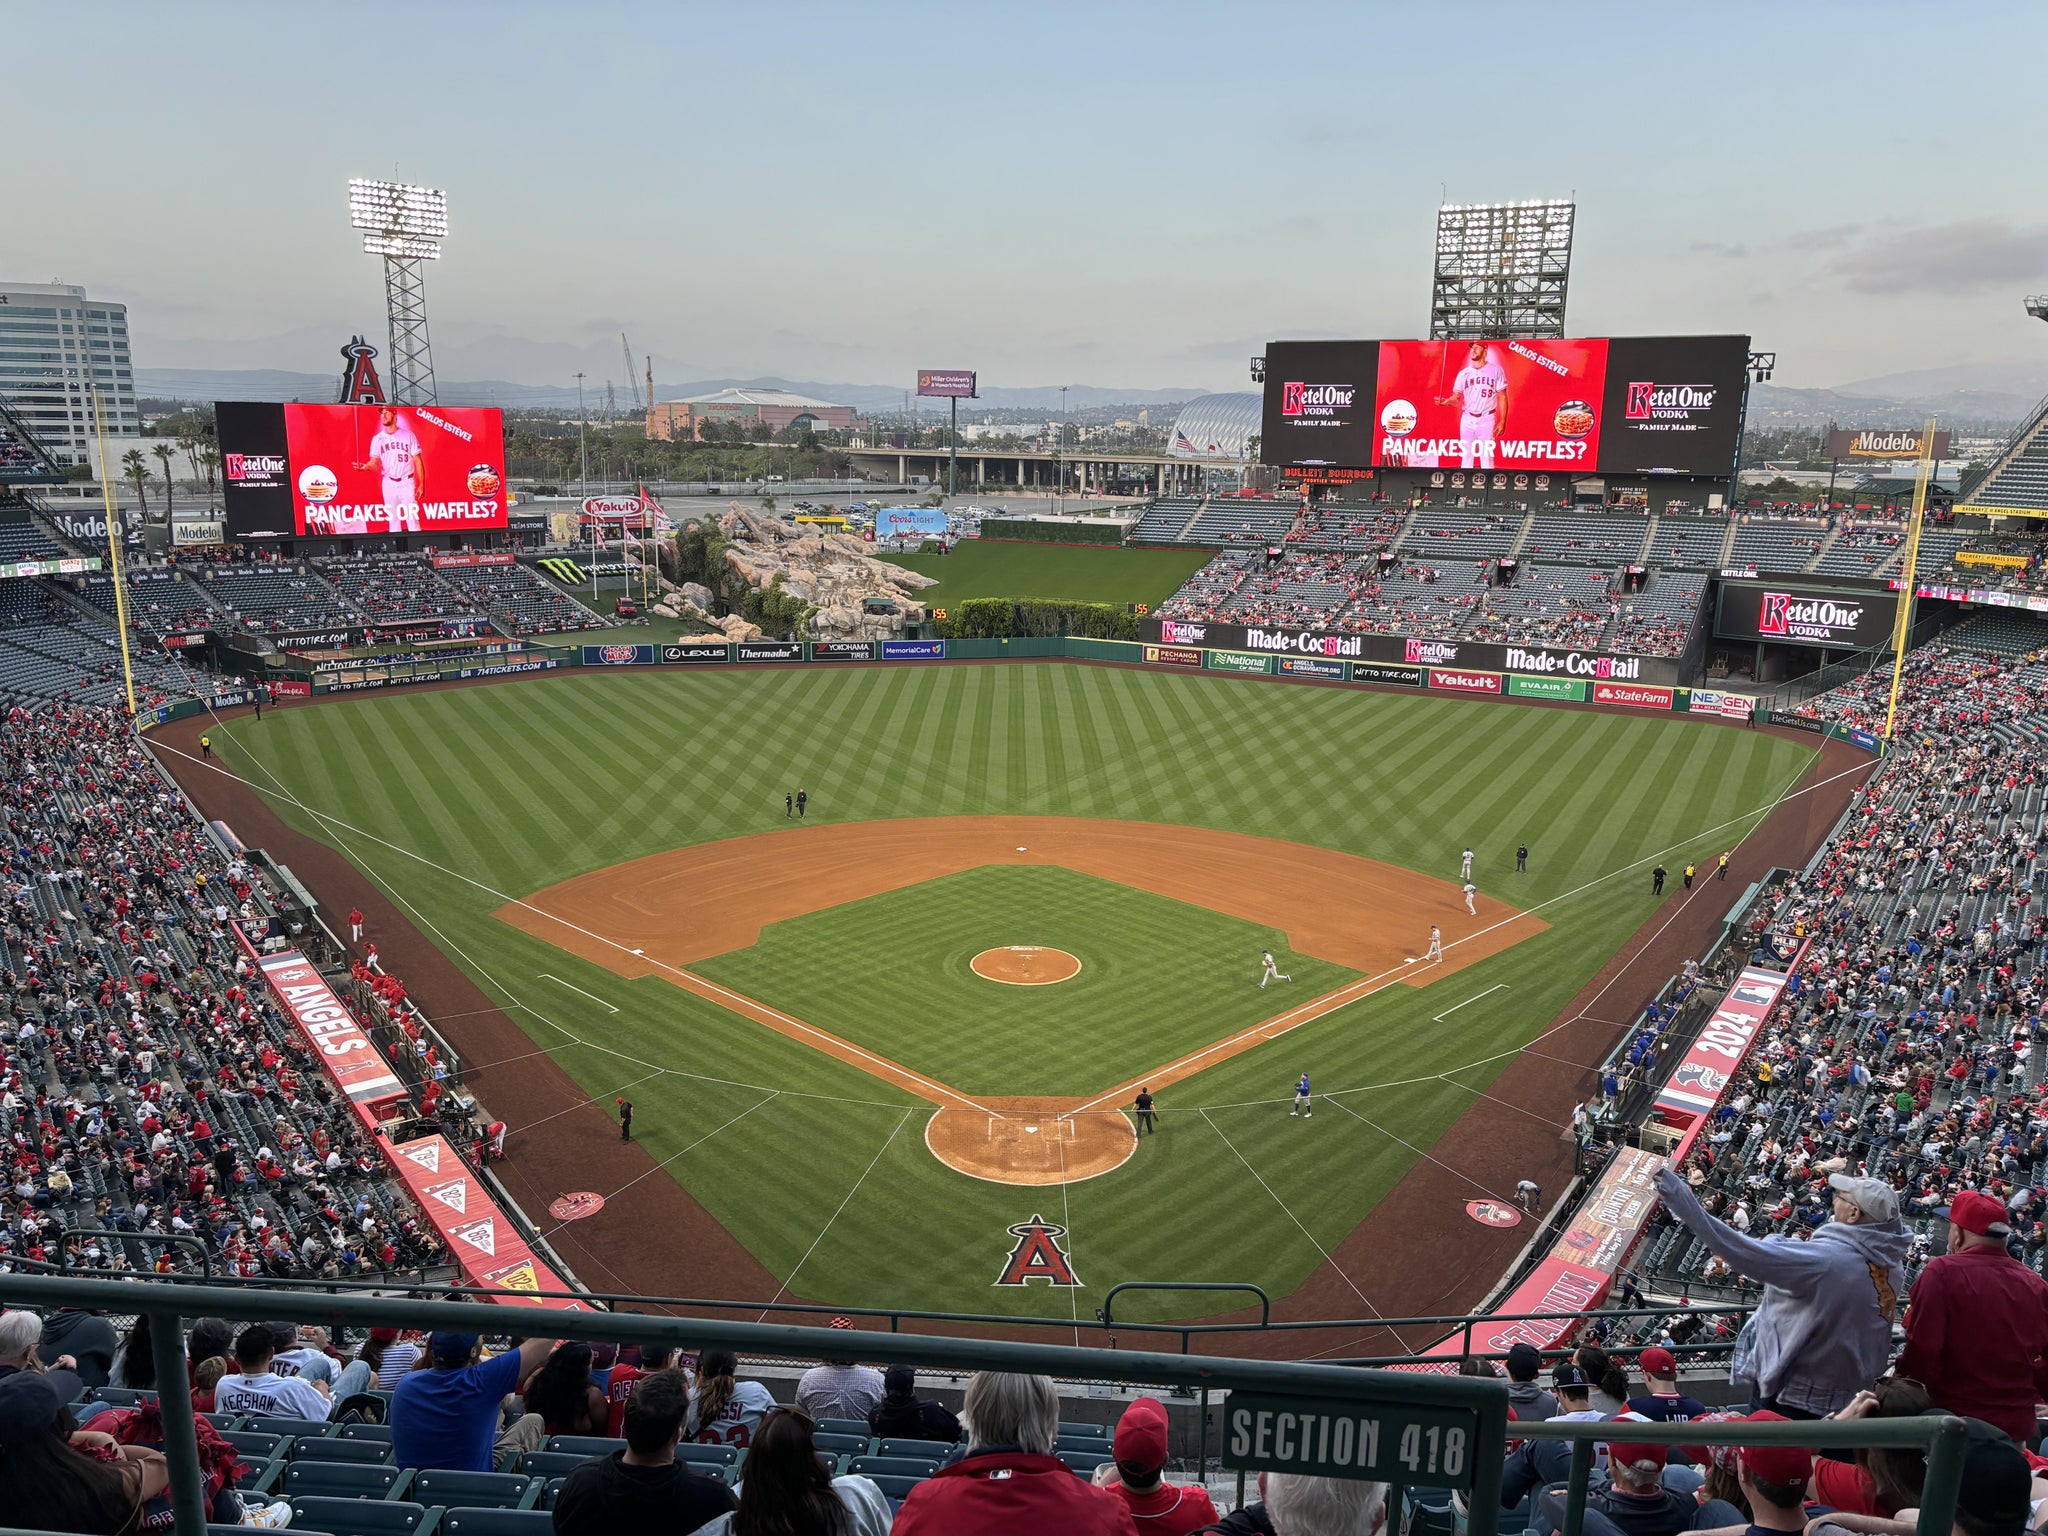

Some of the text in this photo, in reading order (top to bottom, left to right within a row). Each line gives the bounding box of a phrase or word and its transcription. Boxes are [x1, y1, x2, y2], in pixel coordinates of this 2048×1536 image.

[1508, 341, 1569, 377] CARLOS ESTÉVEZ
[1465, 379, 1495, 390] ANGELS
[1284, 384, 1353, 413] Ketel One
[1481, 389, 1493, 398] 53
[1629, 384, 1713, 416] Ketel One
[416, 408, 444, 427] CARLOS
[1652, 410, 1689, 419] VODKA
[380, 443, 409, 453] ANGELS
[1859, 432, 1915, 451] Modelo
[1382, 438, 1587, 459] PANCAKES OR WAFFLES?
[397, 453, 409, 463] 53
[227, 454, 283, 478] Ketel One
[1285, 468, 1374, 479] BULLEIT BOURBON
[1474, 475, 1485, 483] 29
[1495, 475, 1505, 483] 30
[305, 501, 498, 524] PANCAKES OR WAFFLES?
[596, 502, 637, 512] Yakult
[888, 513, 934, 524] Coors LIGHT
[179, 526, 217, 539] Modelo
[1721, 569, 1743, 577] KETTLE
[1763, 595, 1858, 631] Ketel One
[1162, 621, 1206, 642] Ketel One
[1788, 625, 1831, 638] VODKA
[829, 643, 870, 652] YOKOHAMA
[1247, 629, 1361, 656] Made Cocktail
[682, 649, 726, 657] LEXUS
[740, 649, 791, 658] Thermador
[886, 647, 931, 655] MemorialCare
[1160, 651, 1198, 659] PECHANGA
[1406, 640, 1456, 662] Ketel One
[1226, 655, 1266, 668] National
[1506, 648, 1640, 679] Made Cocktail
[477, 662, 541, 676] 714TICKETS.COM
[1354, 668, 1419, 681] NITTO TIRE.COM
[330, 679, 384, 692] NITTO TIRE.COM
[390, 673, 441, 686] NITTO TIRE.COM
[1435, 673, 1496, 689] Yakult
[215, 694, 243, 708] Modelo
[1772, 714, 1821, 731] HeGetsUs.com
[244, 921, 267, 930] MLB
[1774, 936, 1797, 946] MLB
[281, 984, 368, 1056] ANGELS
[1695, 1010, 1760, 1058] 2024
[1598, 1186, 1636, 1223] COUNTRY
[990, 1214, 1087, 1287] A
[506, 1270, 532, 1288] '02
[221, 1393, 277, 1412] KERSHAW
[1231, 1409, 1467, 1477] SECTION 418
